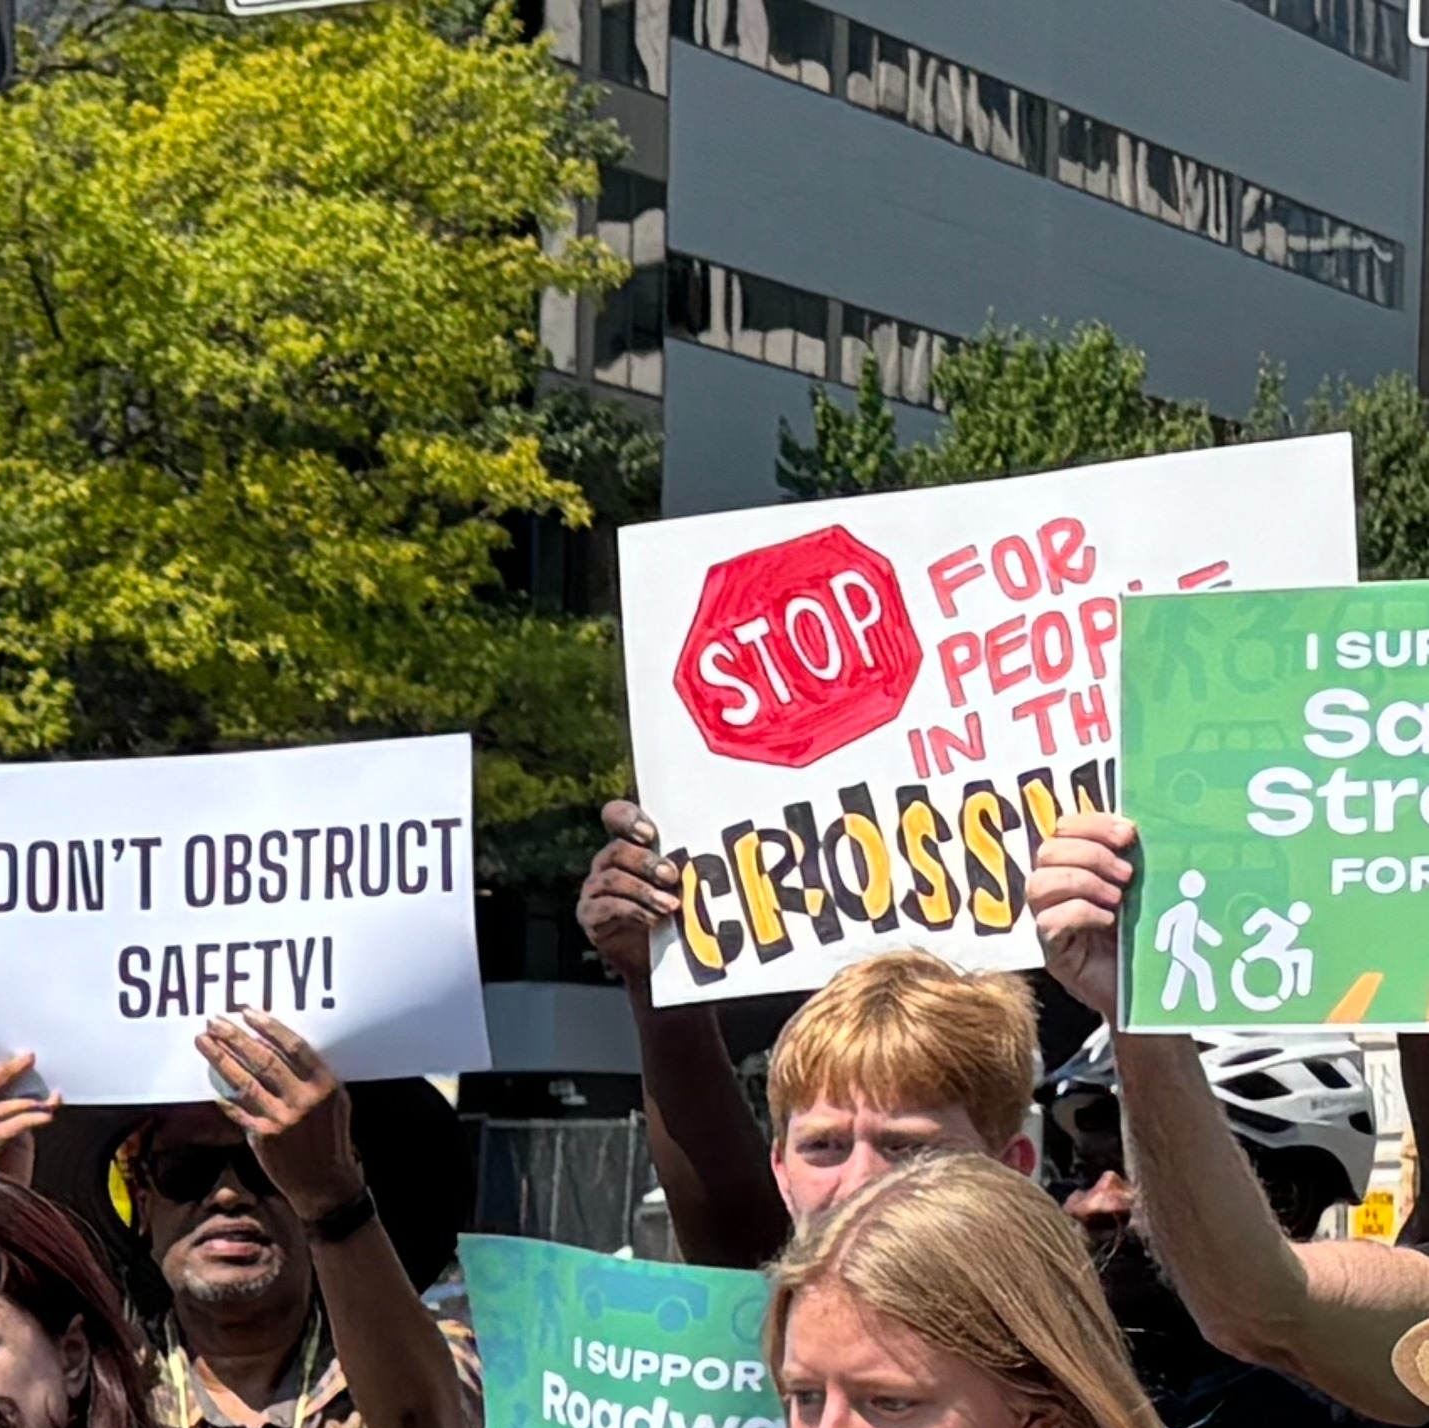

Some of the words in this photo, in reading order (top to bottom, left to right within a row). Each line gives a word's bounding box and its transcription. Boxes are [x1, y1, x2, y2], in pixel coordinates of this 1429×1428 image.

[697, 569, 884, 727] STOP
[926, 516, 1098, 618] FOR
[1305, 633, 1319, 670] I
[907, 709, 985, 779] IN
[1012, 684, 1112, 757] TH
[183, 817, 463, 907] OBSTRUCT
[672, 757, 1118, 986] CROSSW
[117, 935, 336, 1019] SAFETY!
[573, 1336, 583, 1369] I
[585, 1340, 768, 1393] SUPPOR
